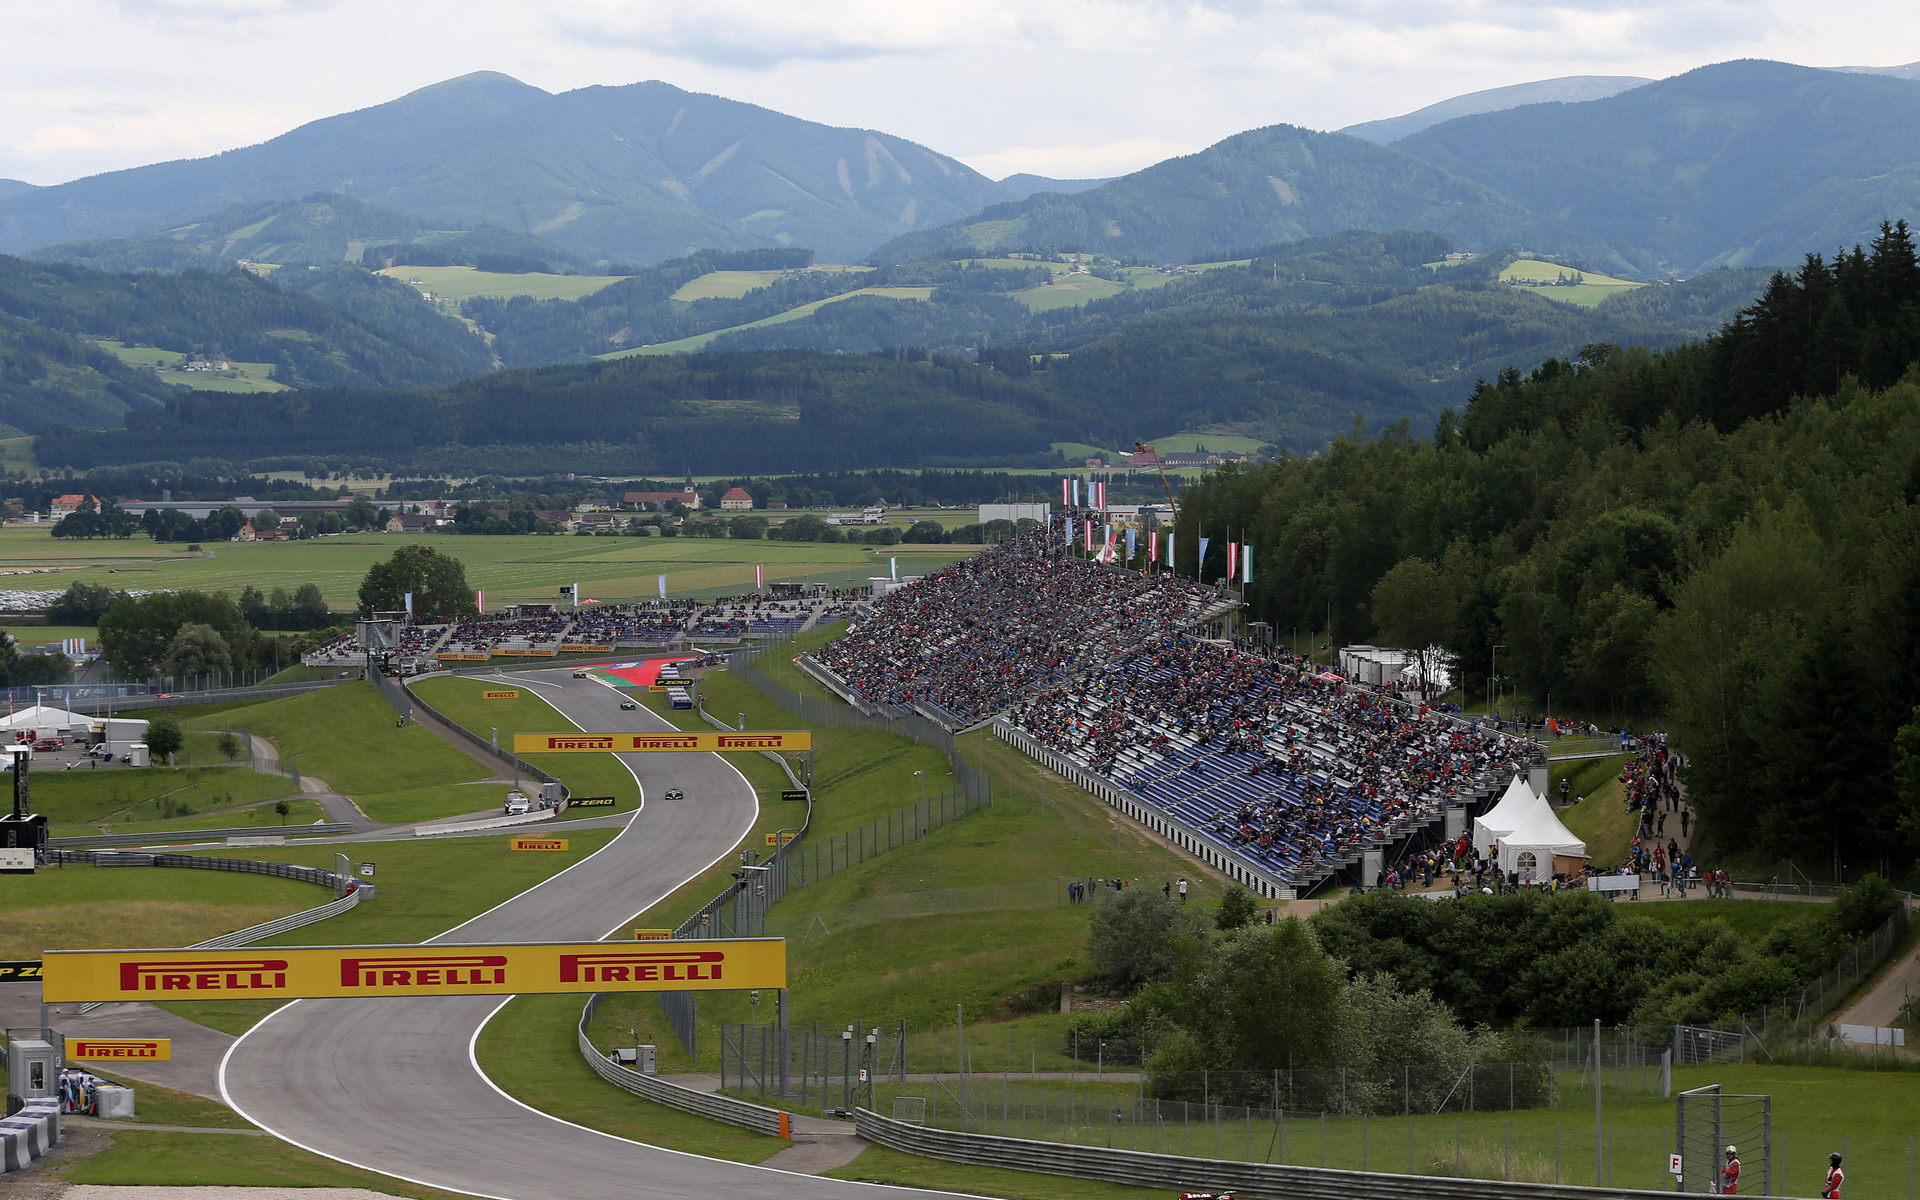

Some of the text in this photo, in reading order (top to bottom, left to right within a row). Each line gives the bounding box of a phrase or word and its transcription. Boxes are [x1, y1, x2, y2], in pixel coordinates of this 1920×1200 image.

[548, 735, 783, 749] PIRELLI PIRELLI PIRELLI
[518, 841, 562, 850] PIRELLI
[119, 951, 725, 991] PIRELLI PIRELLI PIRELLI
[76, 1042, 158, 1057] PIRELLI
[1672, 1158, 1679, 1169] F
